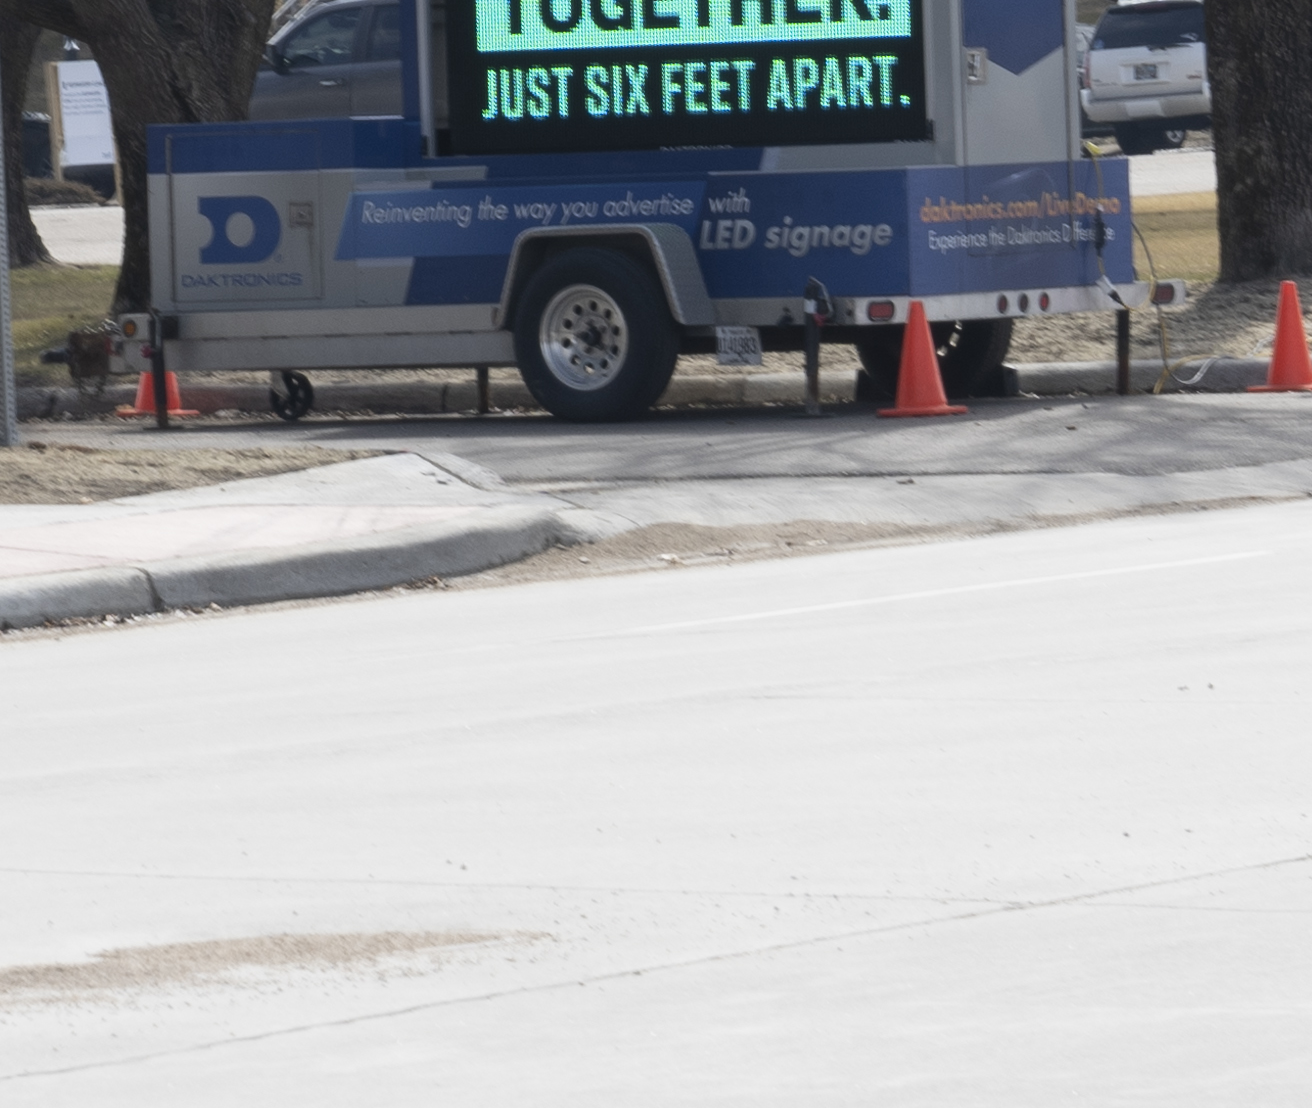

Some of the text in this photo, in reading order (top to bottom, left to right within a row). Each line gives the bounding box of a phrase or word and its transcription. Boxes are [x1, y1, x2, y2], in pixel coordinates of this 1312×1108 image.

[482, 54, 911, 120] JUST SIX FEET APART.
[361, 187, 751, 228] Reinventing the way you advertise with
[699, 215, 893, 257] LED signage
[928, 228, 988, 255] Experience
[989, 226, 1007, 247] the
[1007, 224, 1061, 246] Daktronics
[181, 272, 302, 287] DAKTRONICS
